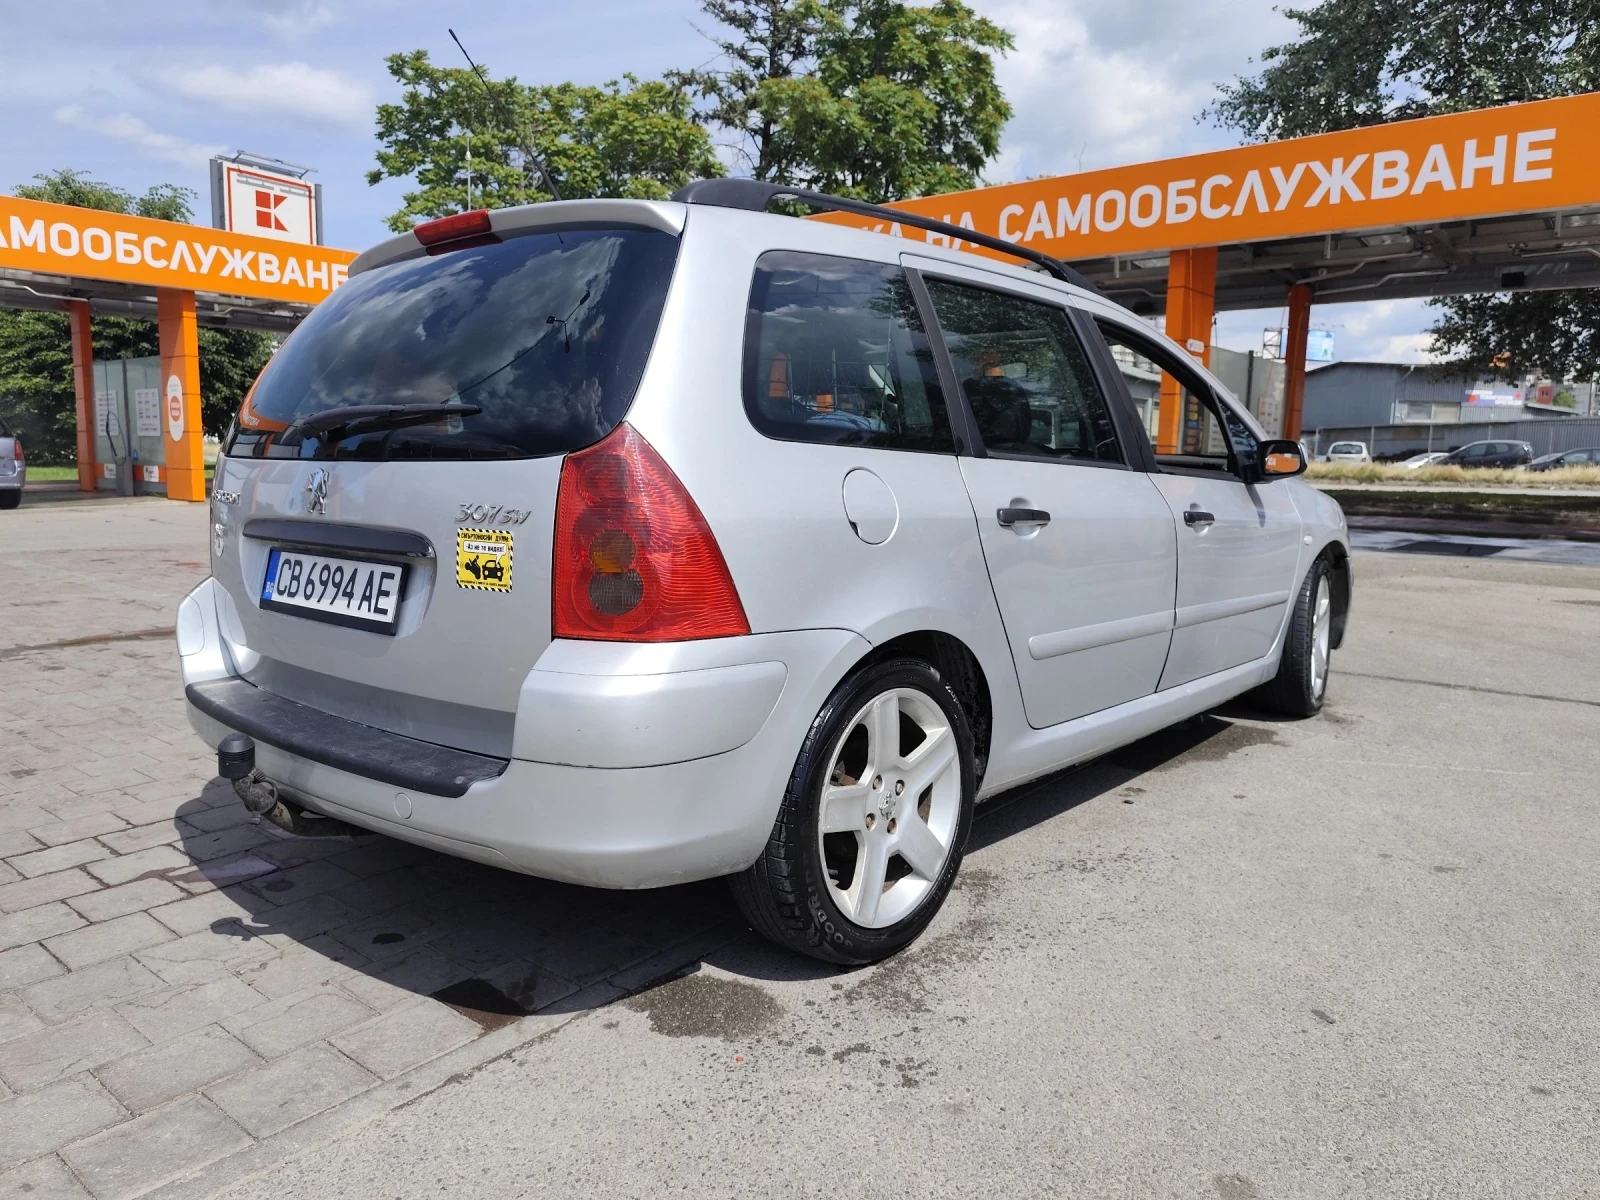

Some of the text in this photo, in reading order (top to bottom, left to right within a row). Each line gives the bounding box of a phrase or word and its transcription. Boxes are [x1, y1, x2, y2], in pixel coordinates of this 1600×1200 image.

[998, 128, 1557, 245] САМООБСЛУЖВАНЕ
[0, 215, 350, 291] МООБСЛУЖВАНЕ
[455, 502, 504, 525] 307
[265, 581, 274, 594] BG
